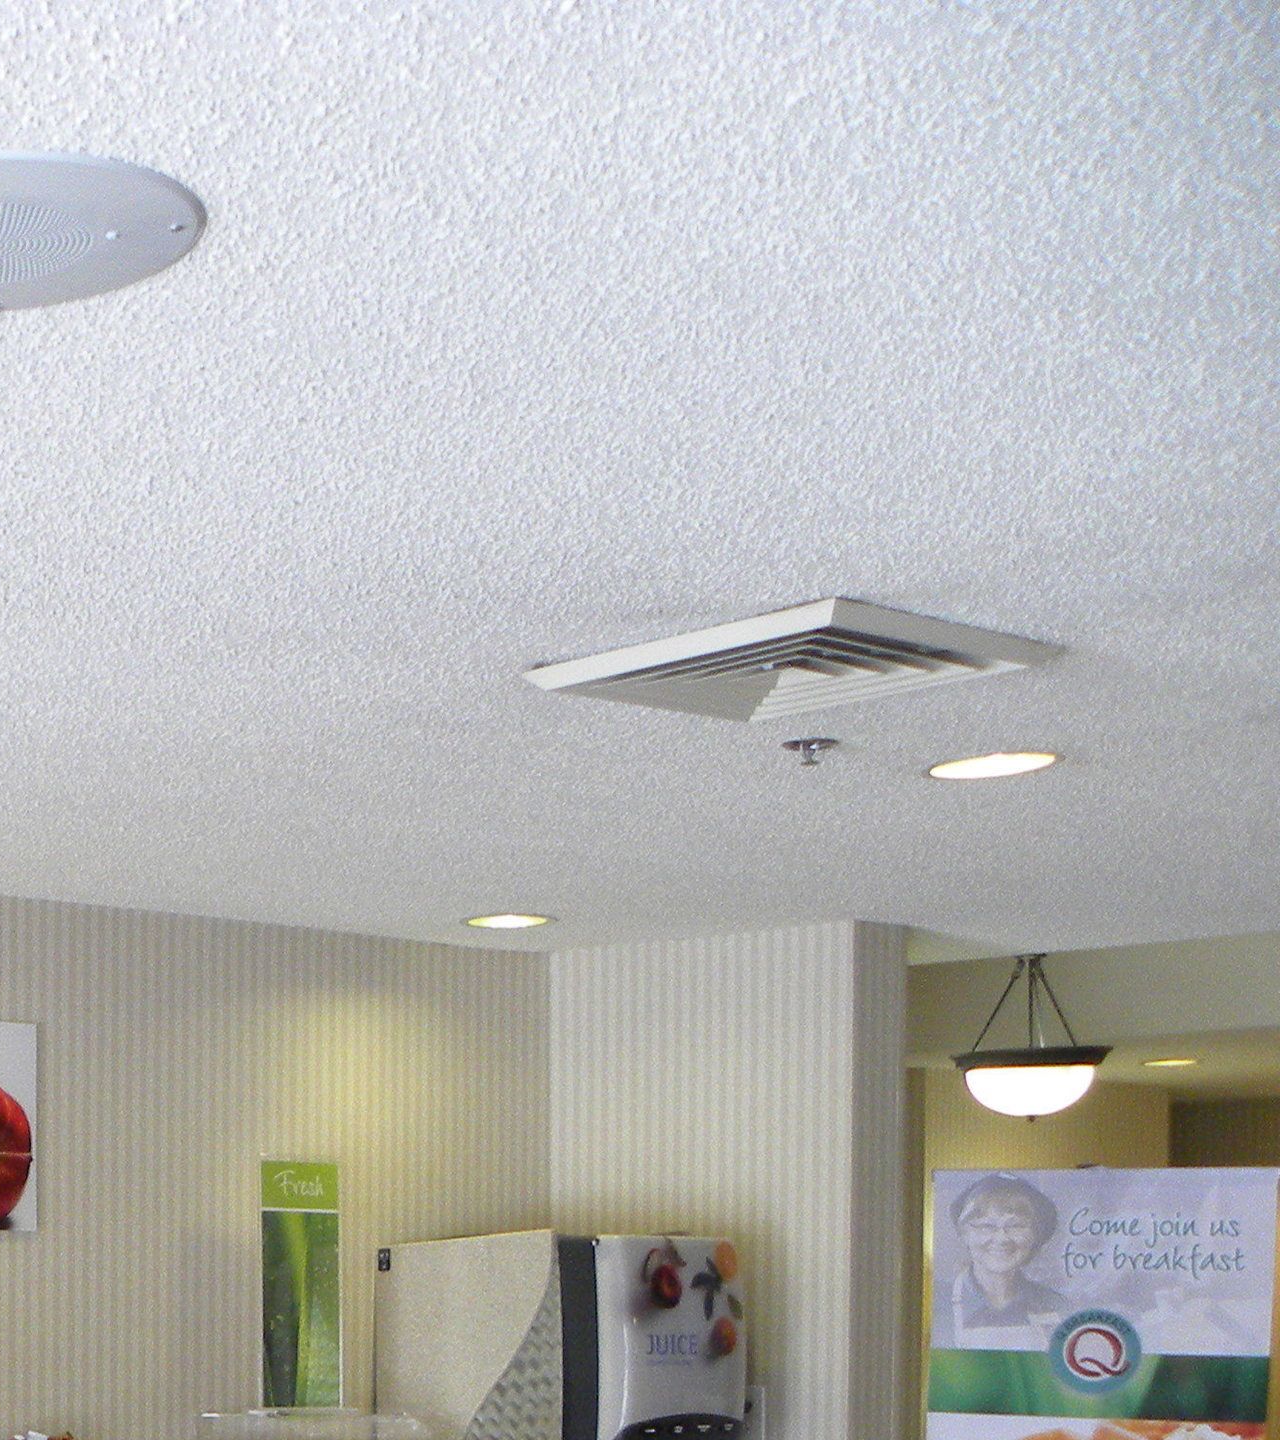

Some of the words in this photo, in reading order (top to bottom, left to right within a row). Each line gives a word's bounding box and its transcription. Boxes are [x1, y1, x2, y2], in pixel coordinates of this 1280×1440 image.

[272, 1168, 324, 1196] Fresh
[1069, 1206, 1141, 1237] Come
[1144, 1211, 1199, 1249] join
[1209, 1219, 1241, 1238] us
[1062, 1242, 1103, 1279] for
[1112, 1243, 1246, 1281] breakfast
[646, 1333, 698, 1356] JUICE
[1064, 1326, 1130, 1378] Q
